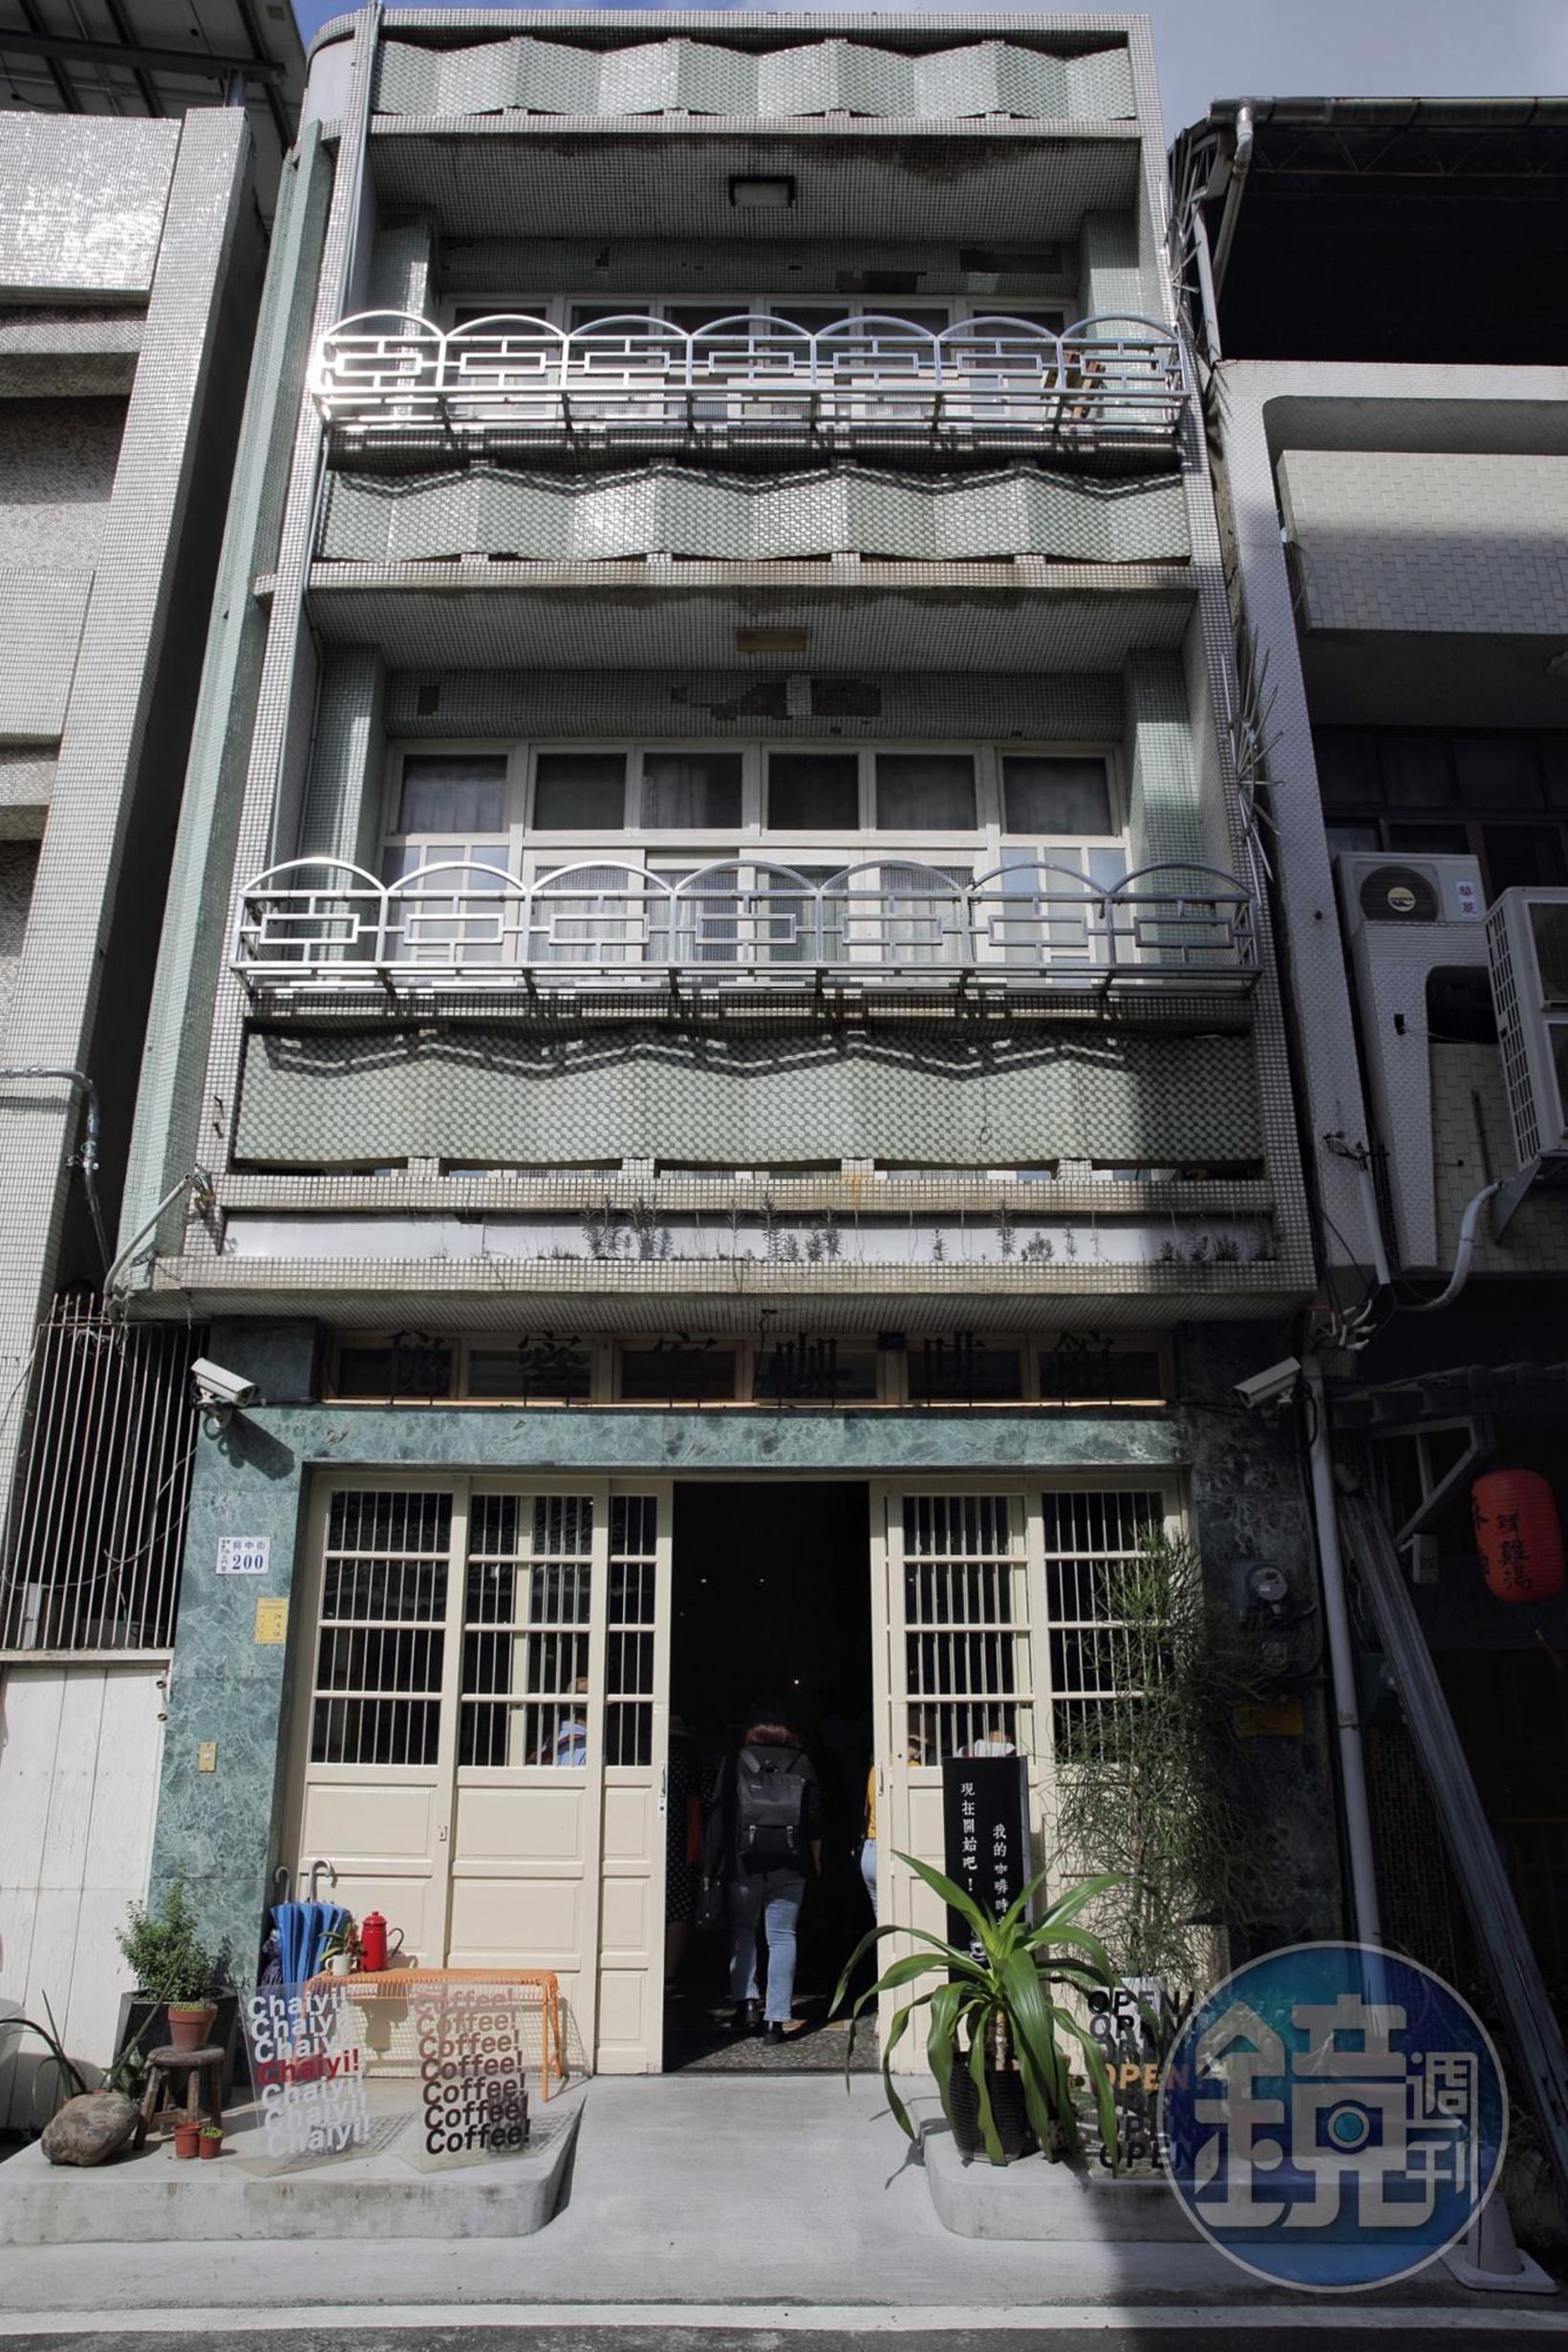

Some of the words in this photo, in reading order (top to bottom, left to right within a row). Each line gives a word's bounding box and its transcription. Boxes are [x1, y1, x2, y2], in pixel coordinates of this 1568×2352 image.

[232, 1554, 264, 1570] 200
[247, 1987, 347, 2019] Chaiyi!
[414, 1988, 513, 2015] Coffee!
[251, 2010, 350, 2041] Chaiy
[417, 2009, 516, 2037] Coffee!
[254, 2032, 354, 2063] Chaiy
[419, 2029, 520, 2060] Coffee!
[258, 2048, 360, 2086] Chaiyi!
[420, 2050, 523, 2082] Coffee!
[422, 2072, 526, 2105] Coffee!
[424, 2091, 528, 2130] Coffee!
[426, 2118, 530, 2155] Coffee!
